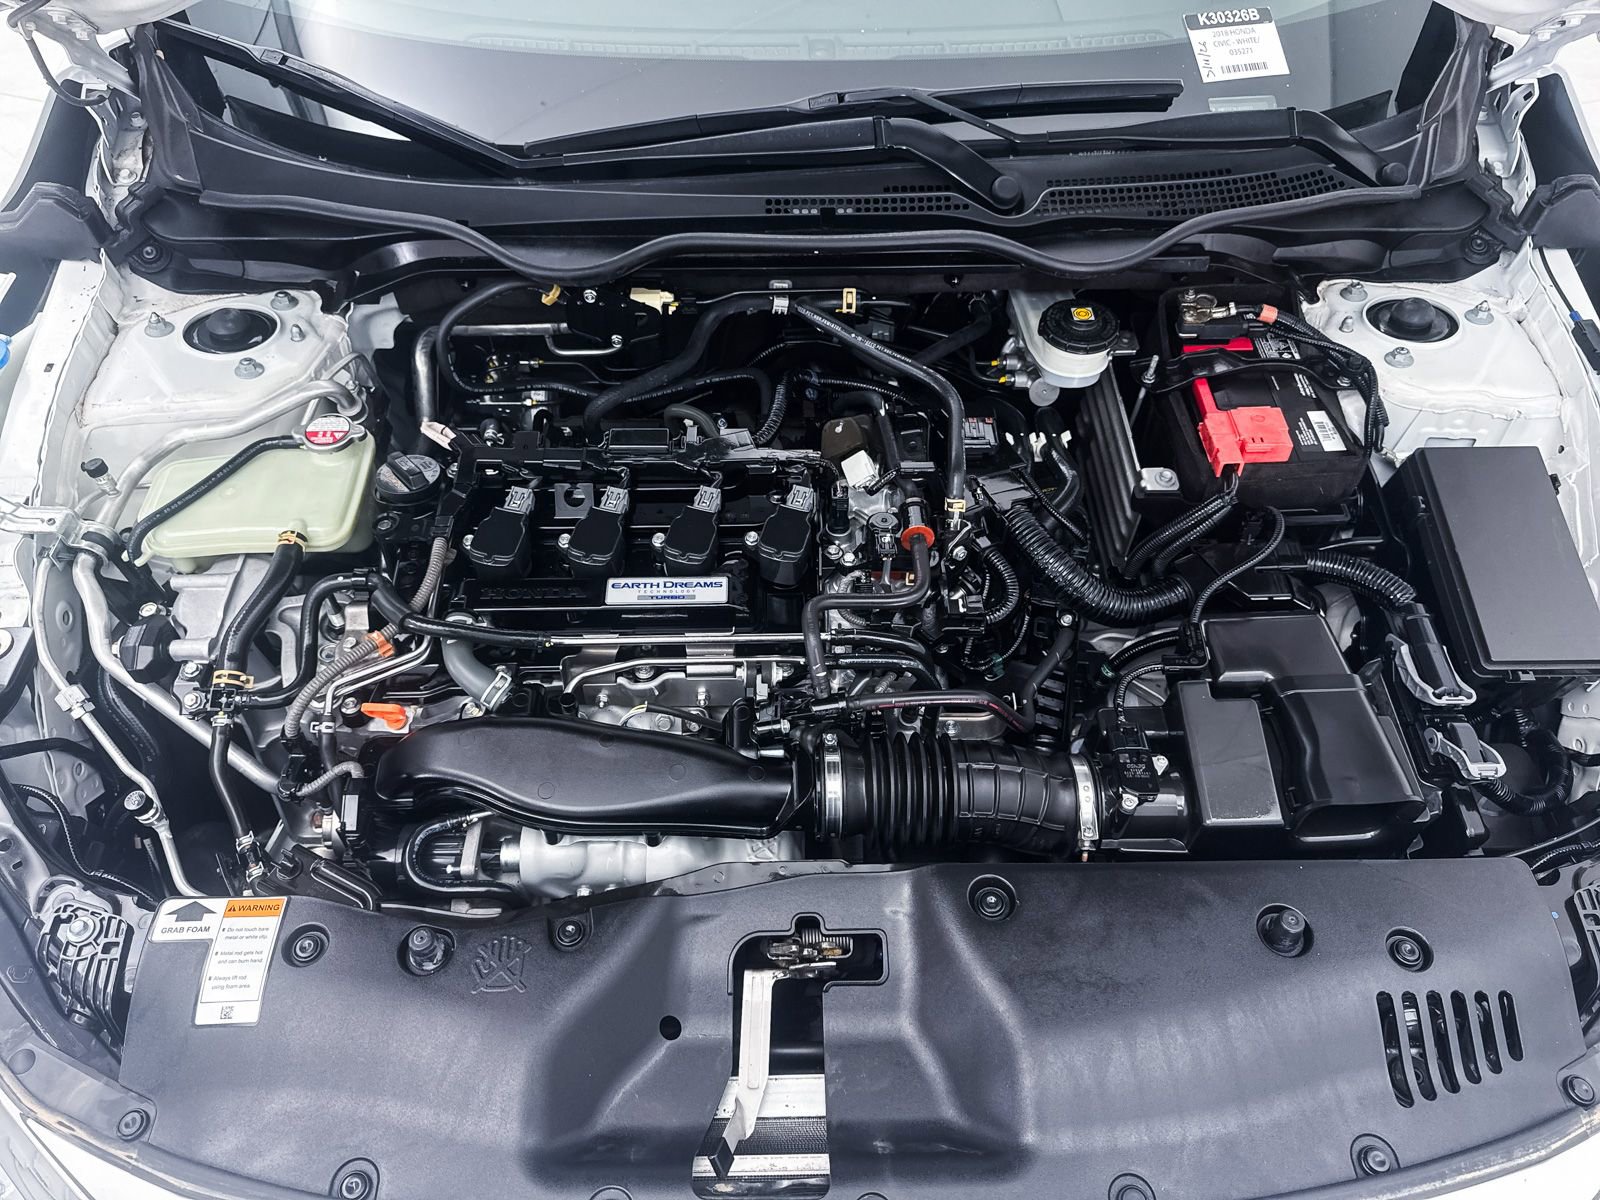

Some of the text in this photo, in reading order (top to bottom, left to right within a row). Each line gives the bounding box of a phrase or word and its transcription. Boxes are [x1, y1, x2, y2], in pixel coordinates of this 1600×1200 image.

[1197, 8, 1260, 26] K30326B
[1212, 27, 1257, 38] 2018 HONDA
[1213, 39, 1231, 48] CIVIC
[1228, 47, 1254, 56] 035271
[479, 587, 588, 600] HONDA
[238, 904, 280, 912] WARNING
[160, 926, 185, 934] GRAB
